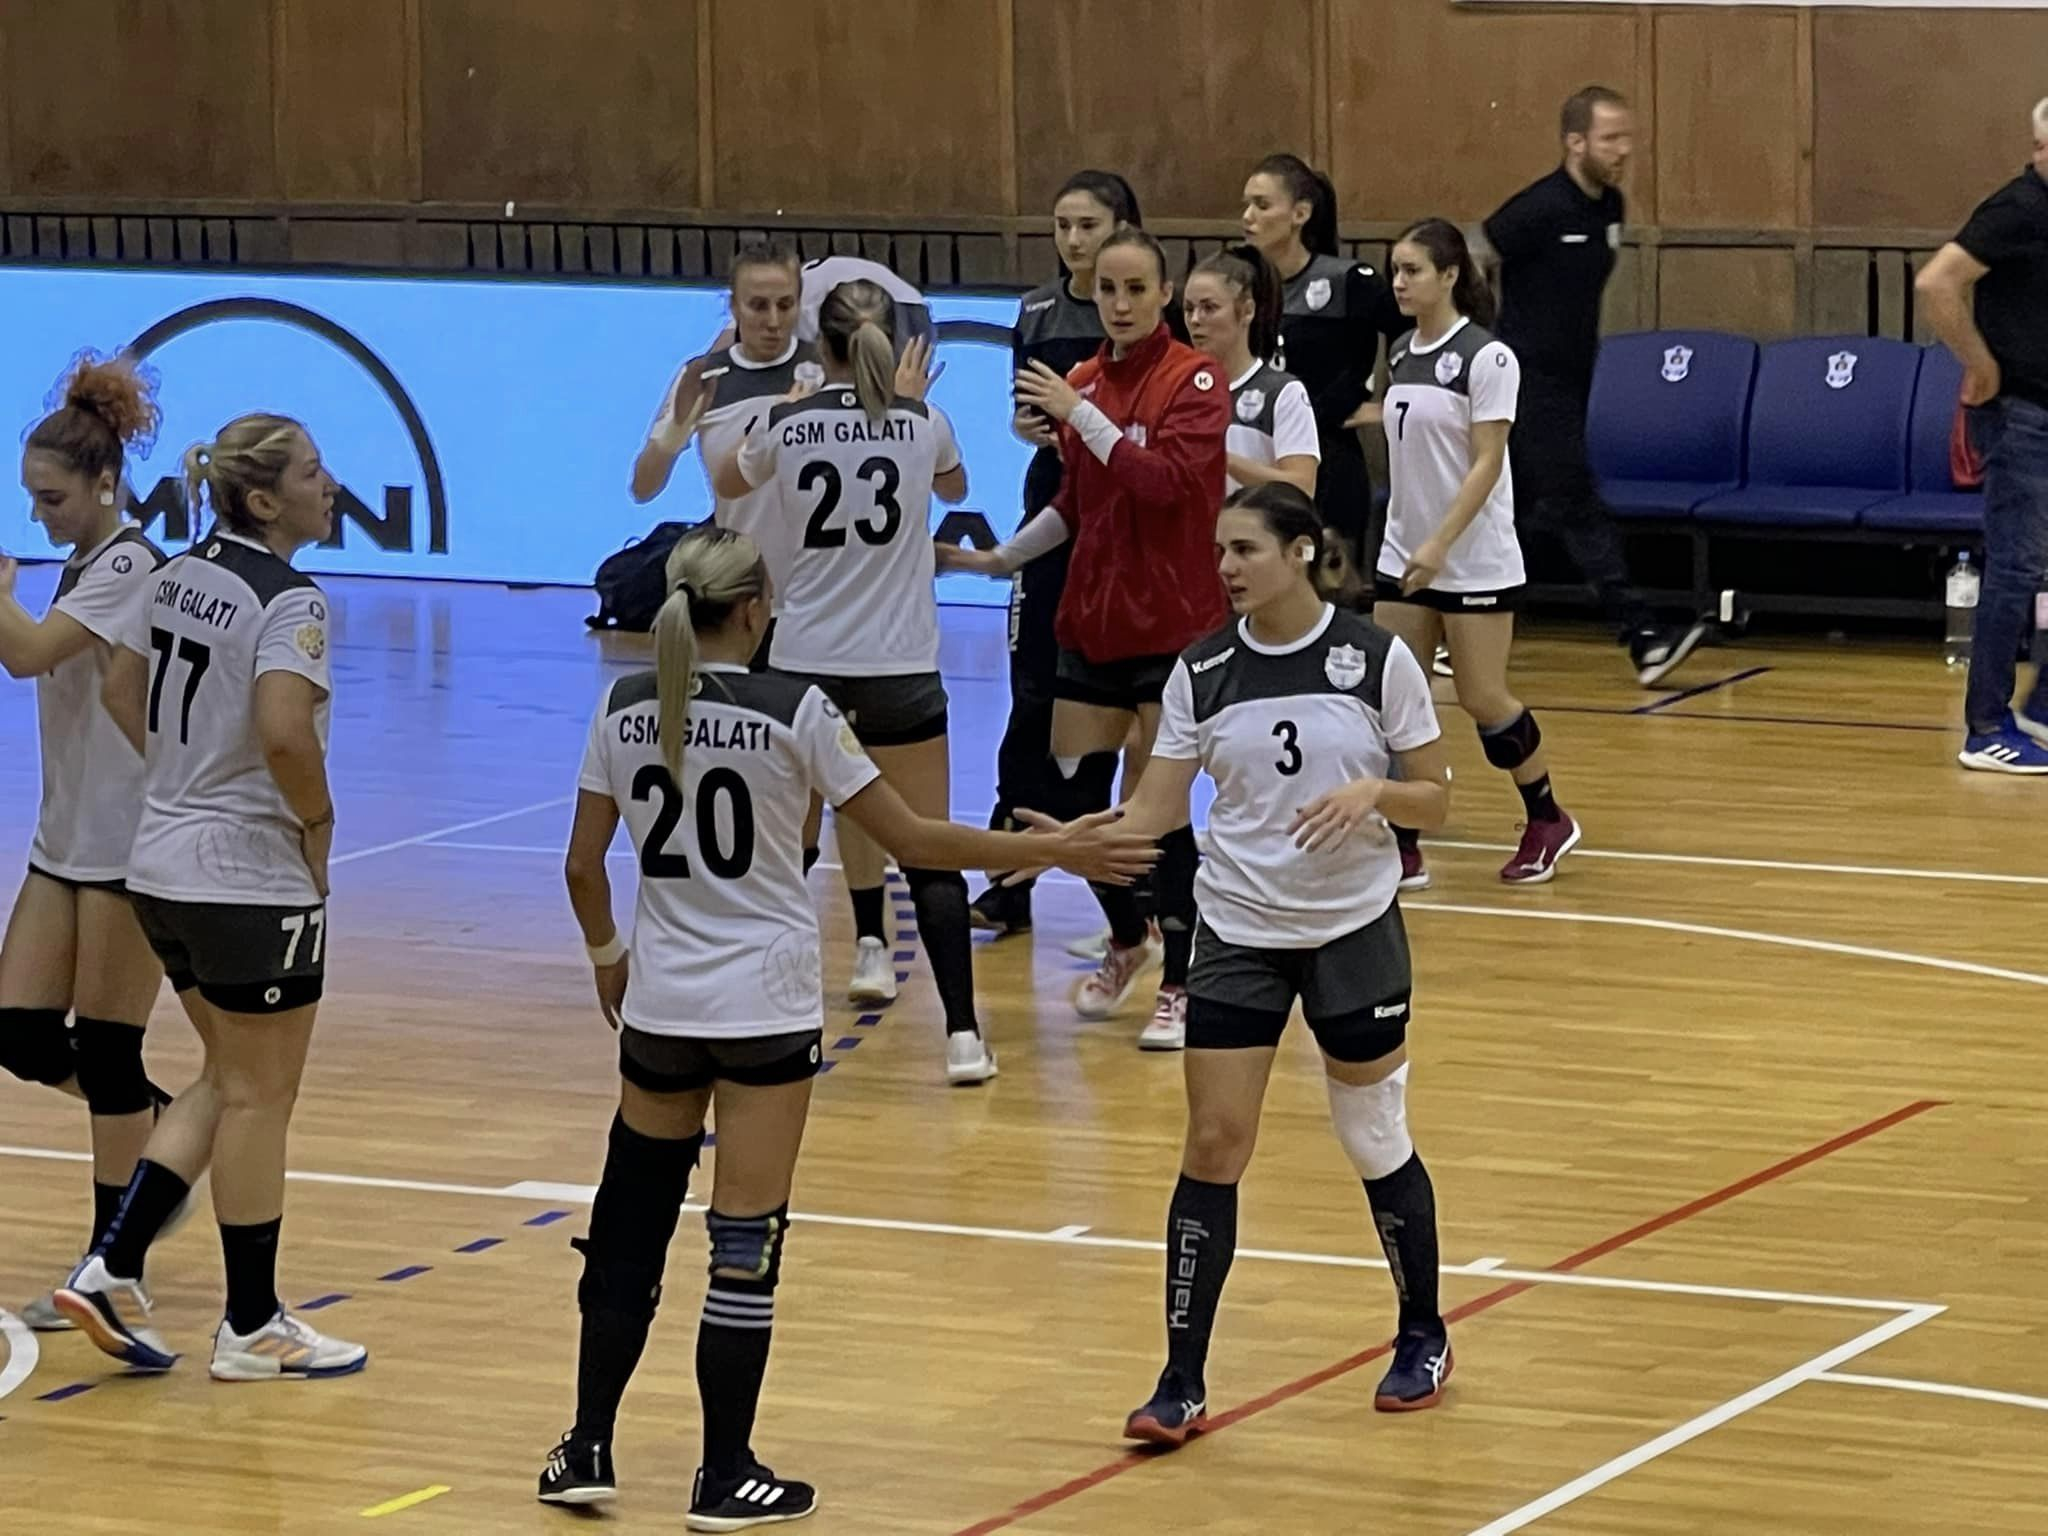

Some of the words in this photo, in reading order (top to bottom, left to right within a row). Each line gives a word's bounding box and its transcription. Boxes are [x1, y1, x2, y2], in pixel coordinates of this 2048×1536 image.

[783, 421, 825, 447] CSM
[834, 418, 914, 443] GALATI
[1395, 401, 1410, 441] 7
[118, 476, 413, 554] MN
[797, 456, 901, 549] 23
[154, 579, 180, 609] CSM
[180, 587, 238, 631] GALATI
[149, 626, 210, 746] 77
[1271, 720, 1303, 776] 3
[631, 764, 755, 880] 20
[281, 908, 325, 970] 77
[1169, 1218, 1210, 1329] kalenji
